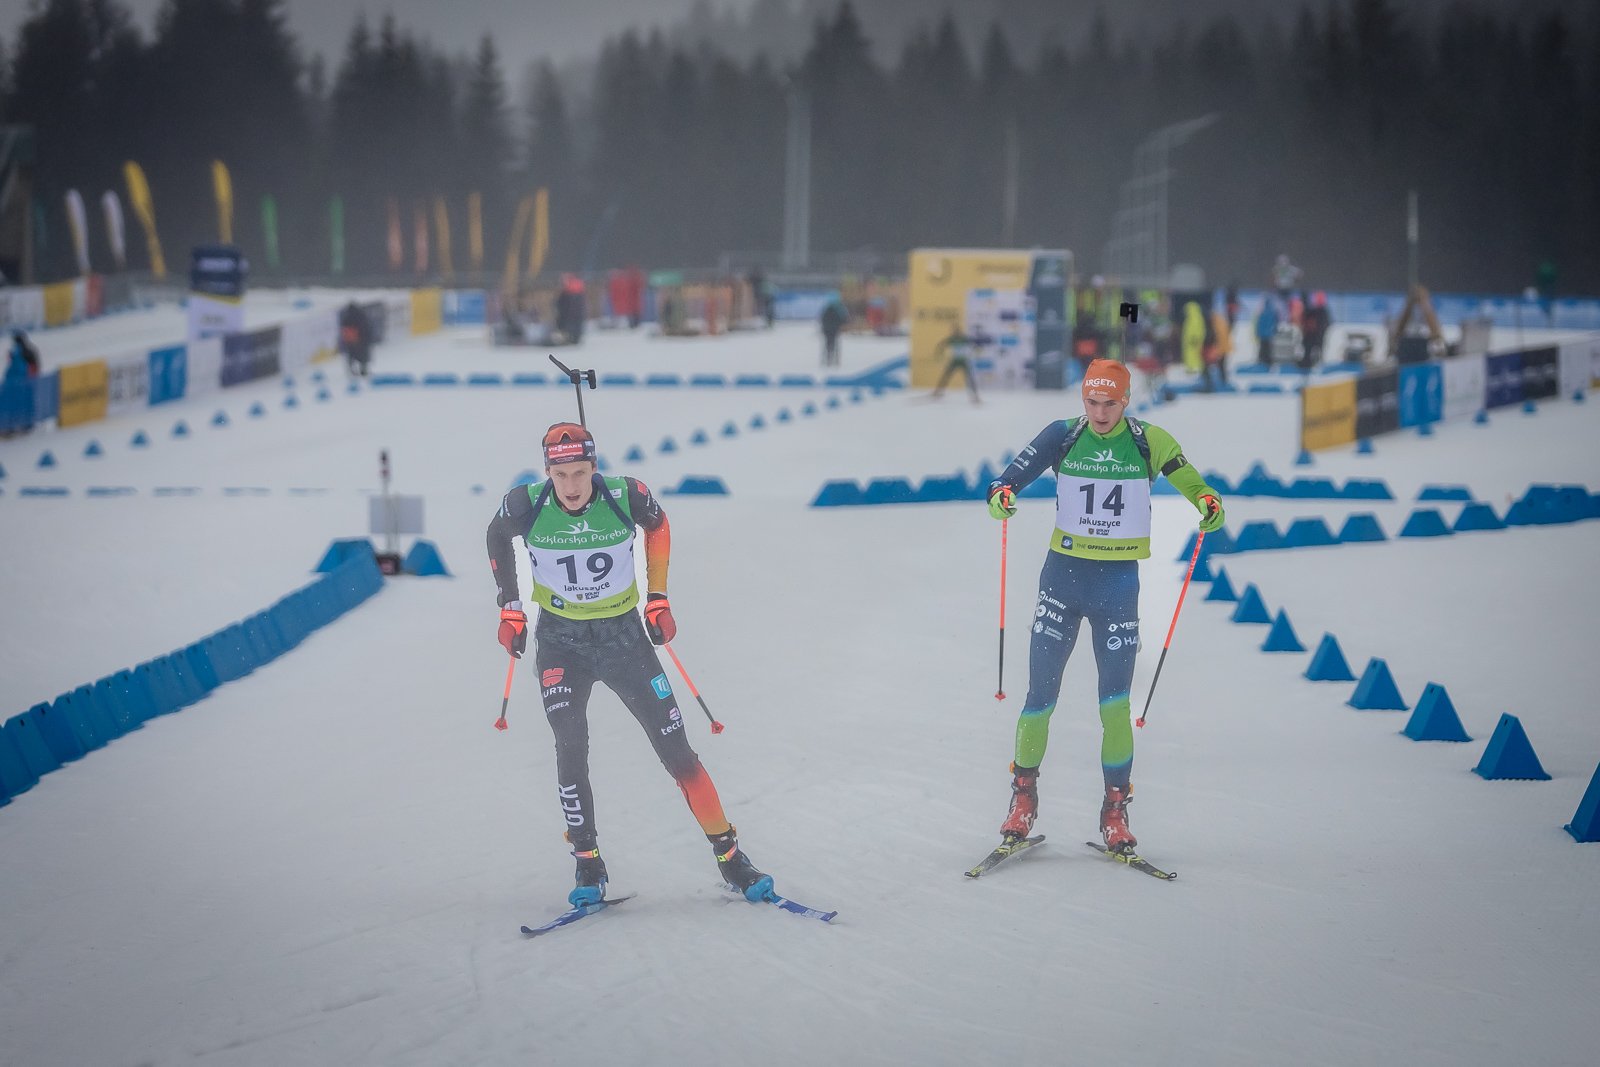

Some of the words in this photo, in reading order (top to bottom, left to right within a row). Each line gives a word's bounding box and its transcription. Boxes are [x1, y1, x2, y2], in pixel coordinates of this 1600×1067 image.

[1063, 459, 1108, 473] Szklarska
[1079, 483, 1124, 516] 14
[1079, 517, 1121, 528] Jakuszyce
[534, 534, 587, 545] Szklarska
[591, 528, 628, 541] Poręba
[556, 551, 613, 584] 19
[1046, 611, 1064, 623] NLB
[559, 784, 585, 826] GER
